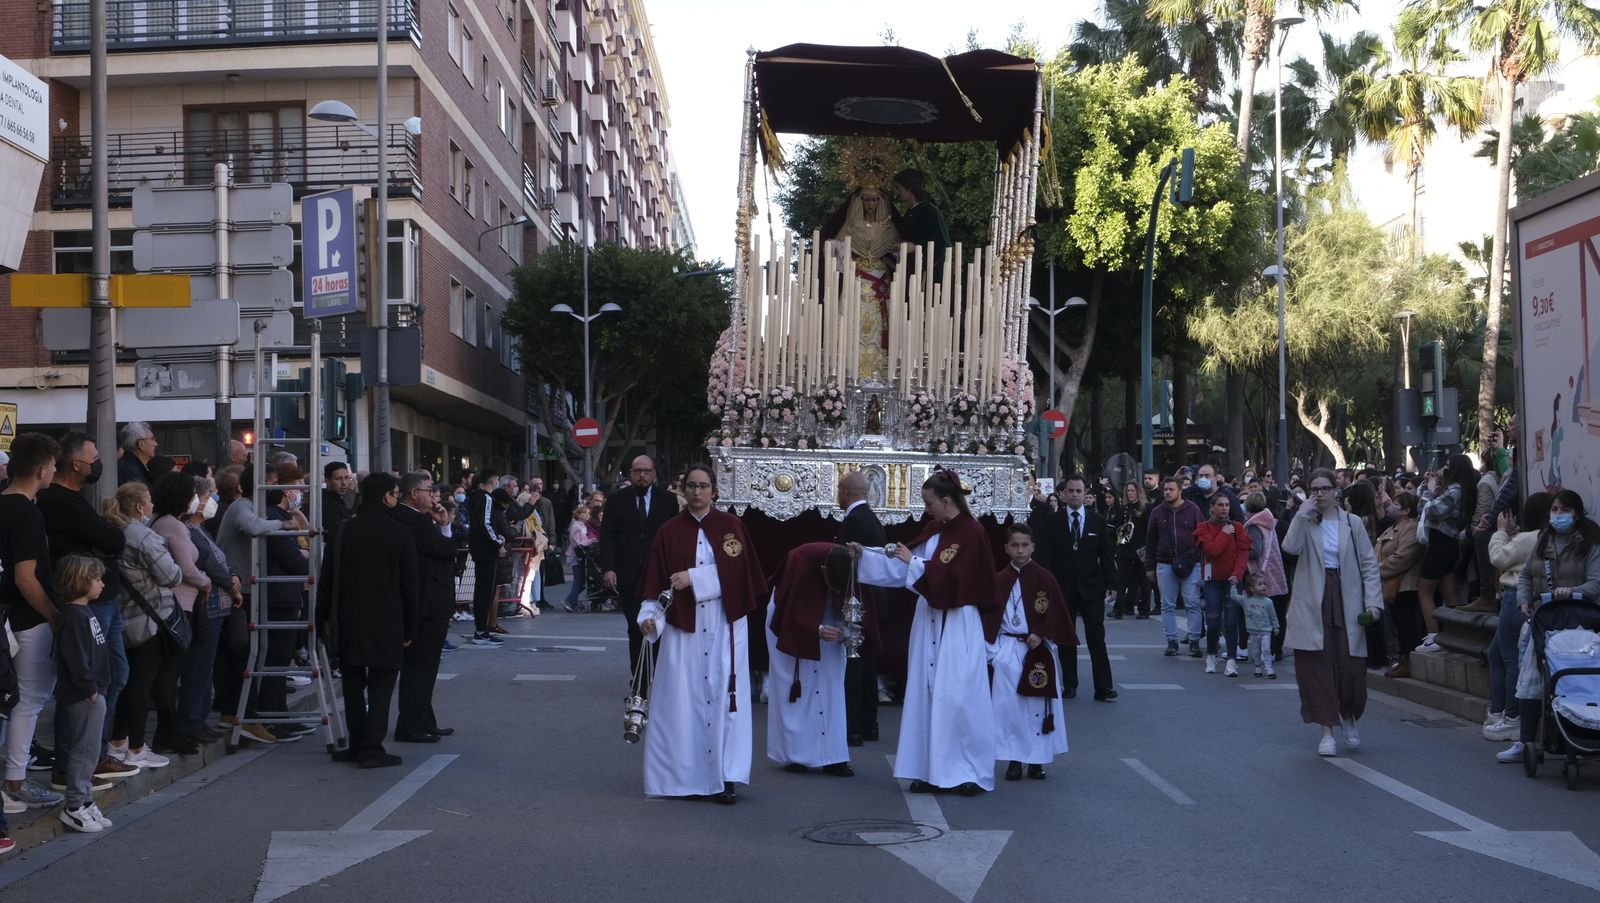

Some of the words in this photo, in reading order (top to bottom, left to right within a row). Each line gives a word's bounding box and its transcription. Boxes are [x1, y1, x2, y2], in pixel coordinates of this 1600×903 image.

[5, 94, 25, 115] DENTAL
[7, 119, 16, 133] 665
[16, 124, 23, 137] 66
[23, 128, 29, 140] 56
[317, 197, 341, 270] P
[312, 278, 323, 294] 24
[325, 275, 348, 292] horas
[1532, 291, 1555, 318] 9,30€
